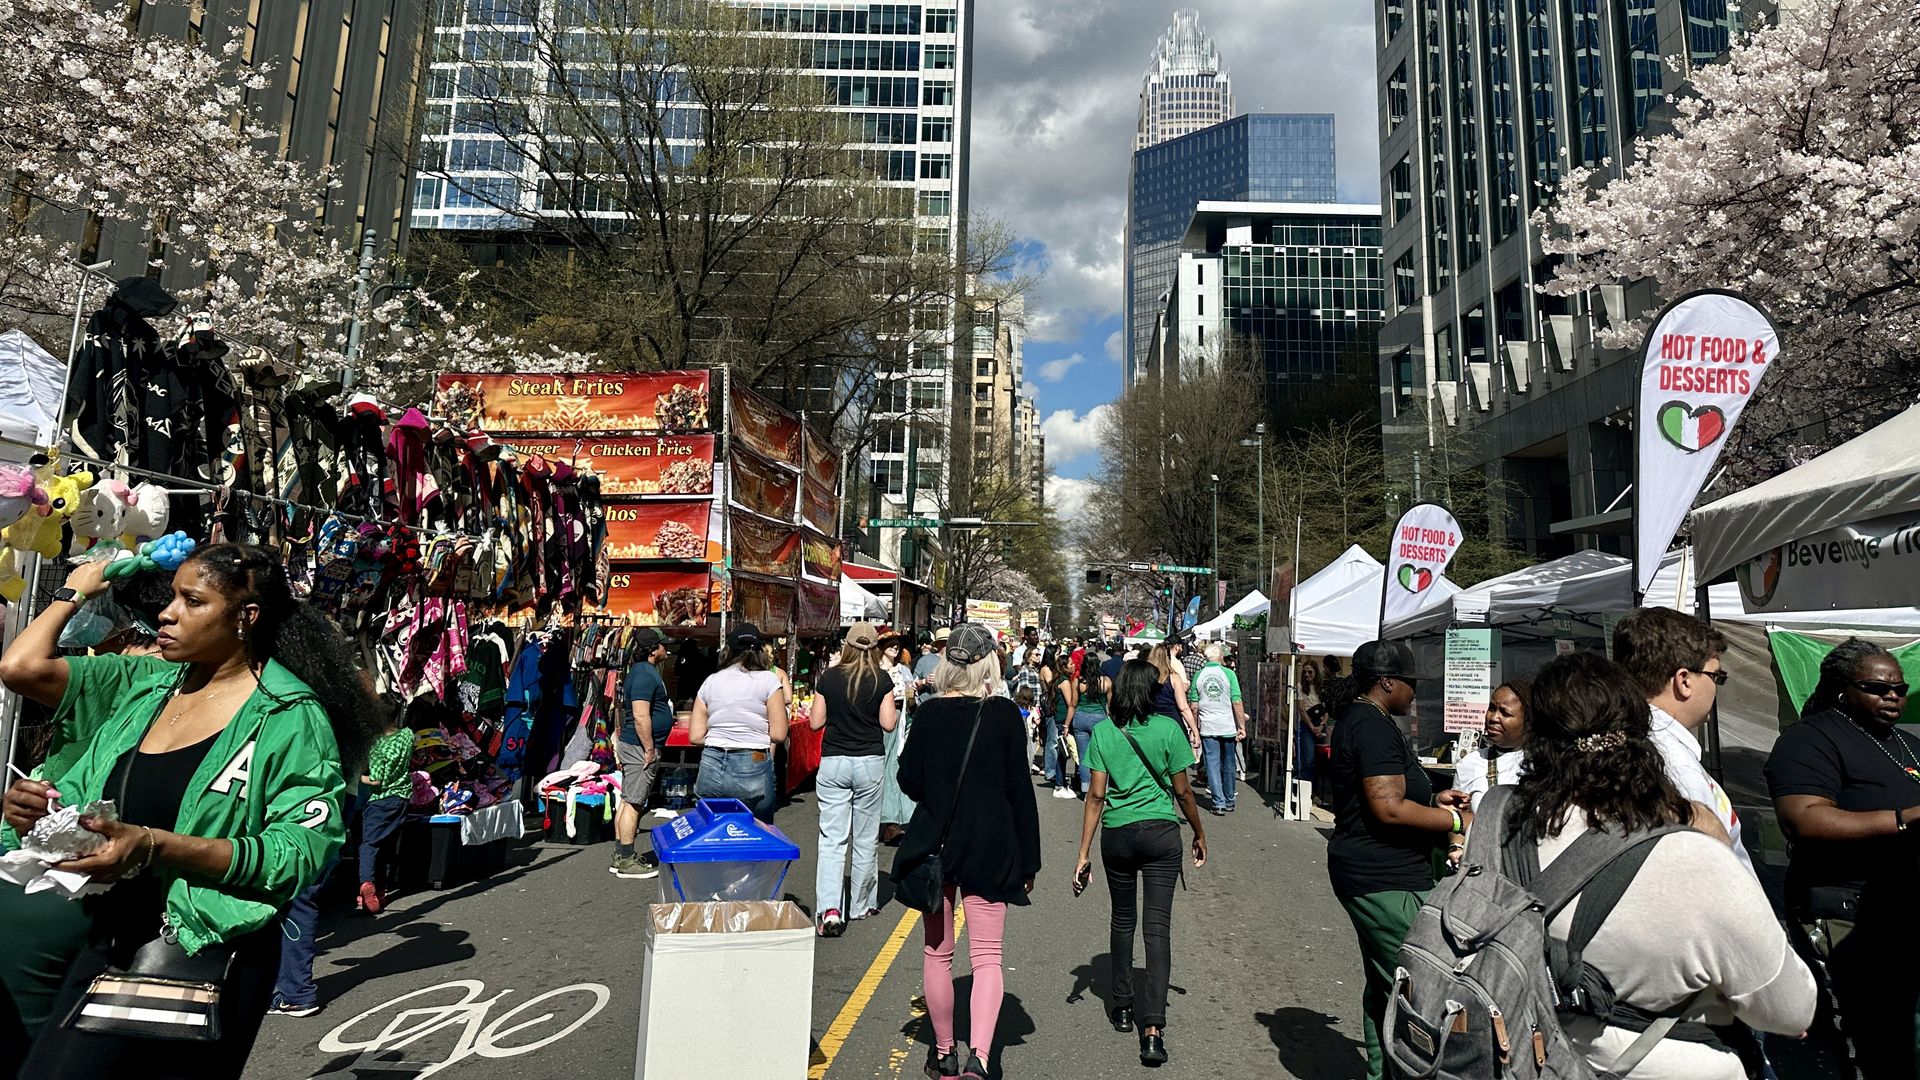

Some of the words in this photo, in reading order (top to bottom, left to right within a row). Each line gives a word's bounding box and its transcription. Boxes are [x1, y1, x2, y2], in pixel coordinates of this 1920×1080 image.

[1661, 334, 1696, 361] HOT
[1700, 336, 1747, 363] FOOD
[1751, 339, 1766, 365] &
[508, 379, 565, 396] Steak
[571, 379, 624, 396] Fries
[1660, 365, 1750, 395] DESSERTS
[590, 444, 650, 457] Chicken
[656, 443, 693, 457] Fries
[605, 505, 638, 522] hos
[894, 519, 913, 527] LUTHER
[1401, 526, 1420, 542] HOT
[1421, 528, 1446, 545] FOOD
[1447, 531, 1456, 547] &
[1400, 543, 1447, 564] DESSERTS
[1787, 536, 1882, 569] Beverage
[610, 574, 631, 588] es
[208, 740, 255, 800] A
[299, 798, 331, 830] 2
